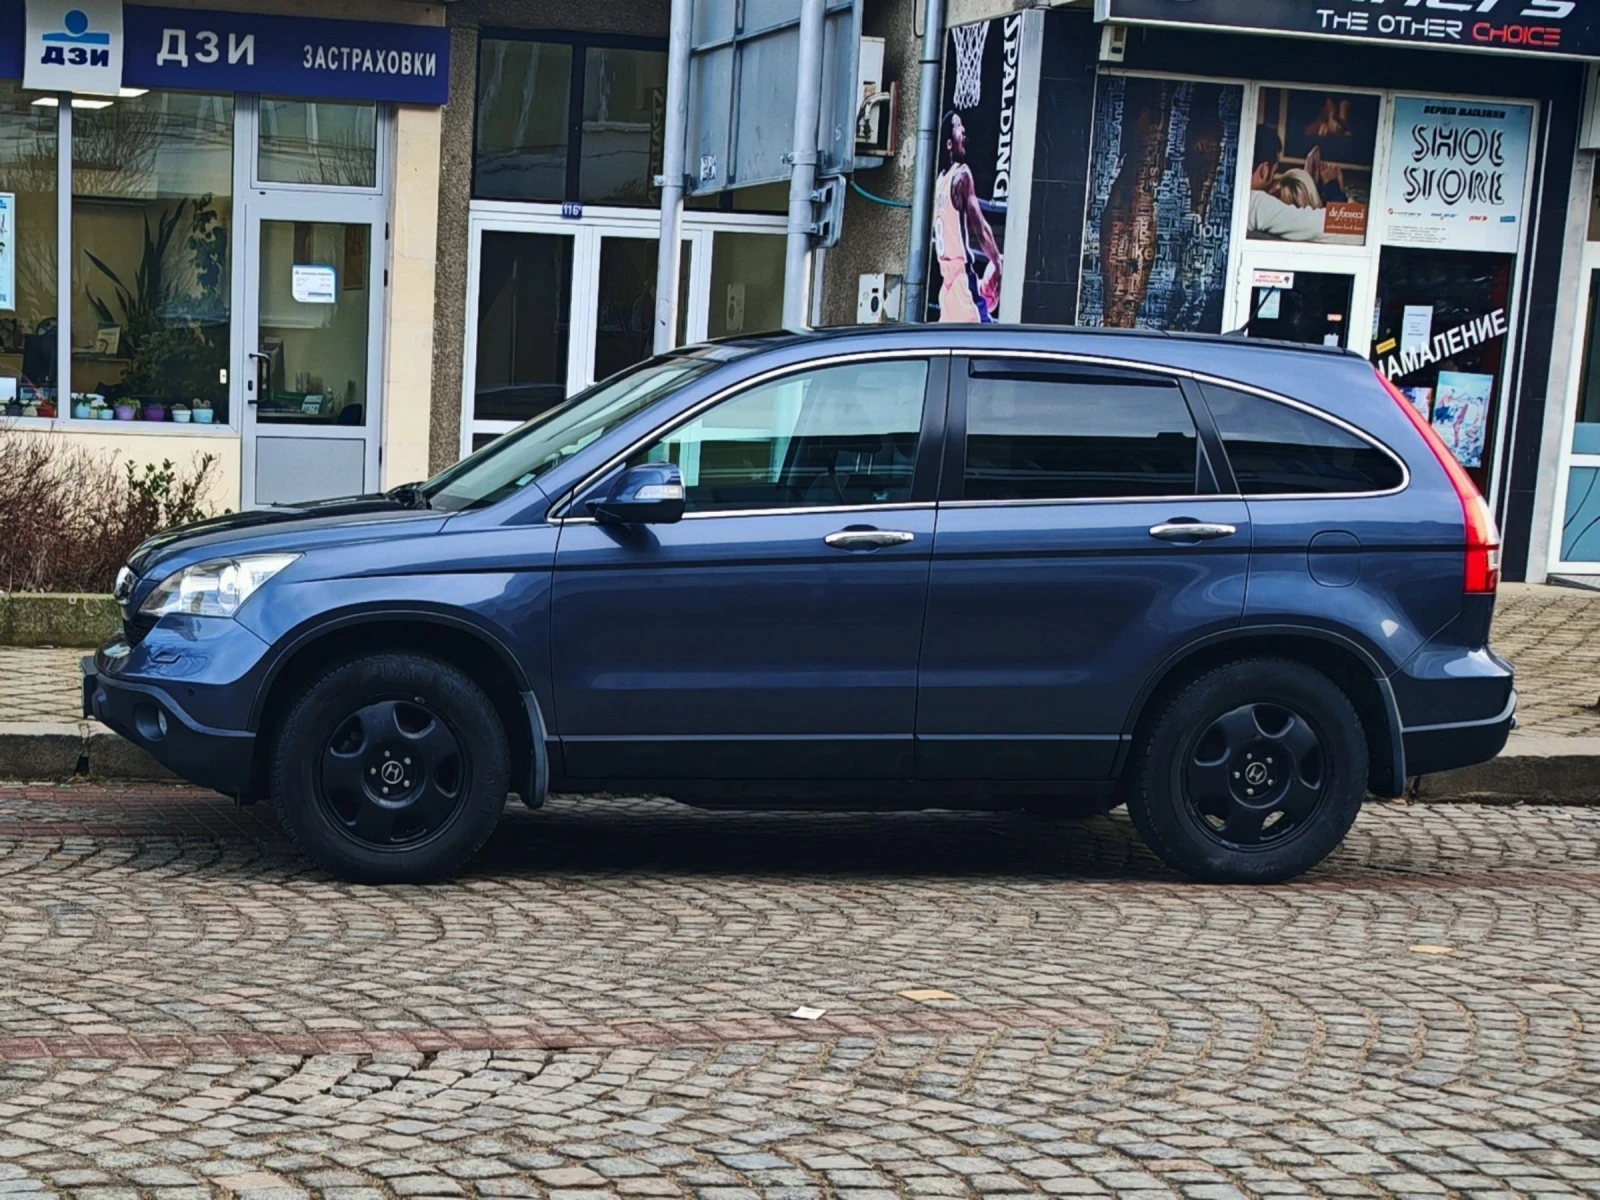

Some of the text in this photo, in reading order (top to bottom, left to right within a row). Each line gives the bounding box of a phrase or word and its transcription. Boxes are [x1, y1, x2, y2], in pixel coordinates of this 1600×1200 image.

[1316, 9, 1369, 31] THE
[1378, 15, 1463, 39] OTHER
[1472, 21, 1561, 47] CHOICE
[40, 46, 109, 67] ДЗИ
[157, 28, 436, 77] ДЗИ ЗАСТРАХОВКИ
[993, 15, 1021, 199] SPALDING
